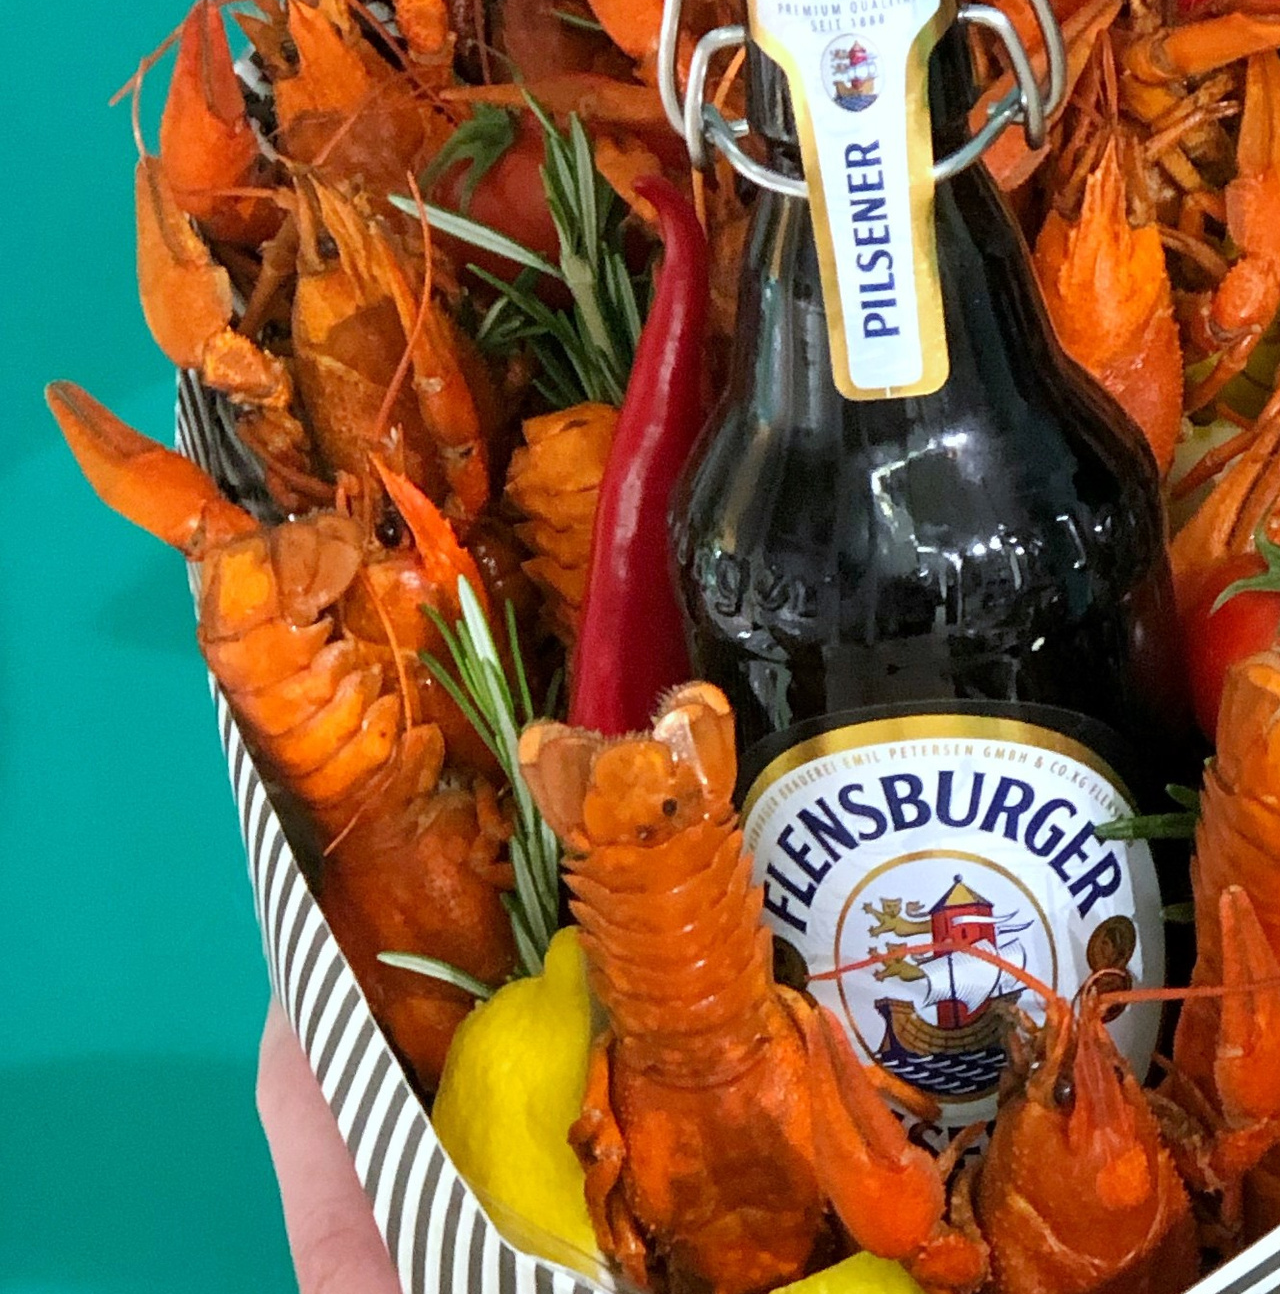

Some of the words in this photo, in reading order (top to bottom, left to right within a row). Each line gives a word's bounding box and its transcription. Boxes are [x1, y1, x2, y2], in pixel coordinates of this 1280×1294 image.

[777, 2, 842, 18] PREMIUM
[844, 138, 901, 340] PILSENER
[843, 749, 882, 769] EMIL
[888, 743, 974, 761] PETERSEN
[983, 745, 1029, 764] GMBH
[1033, 755, 1044, 770] &
[762, 769, 1123, 936] FLENSBURGER
